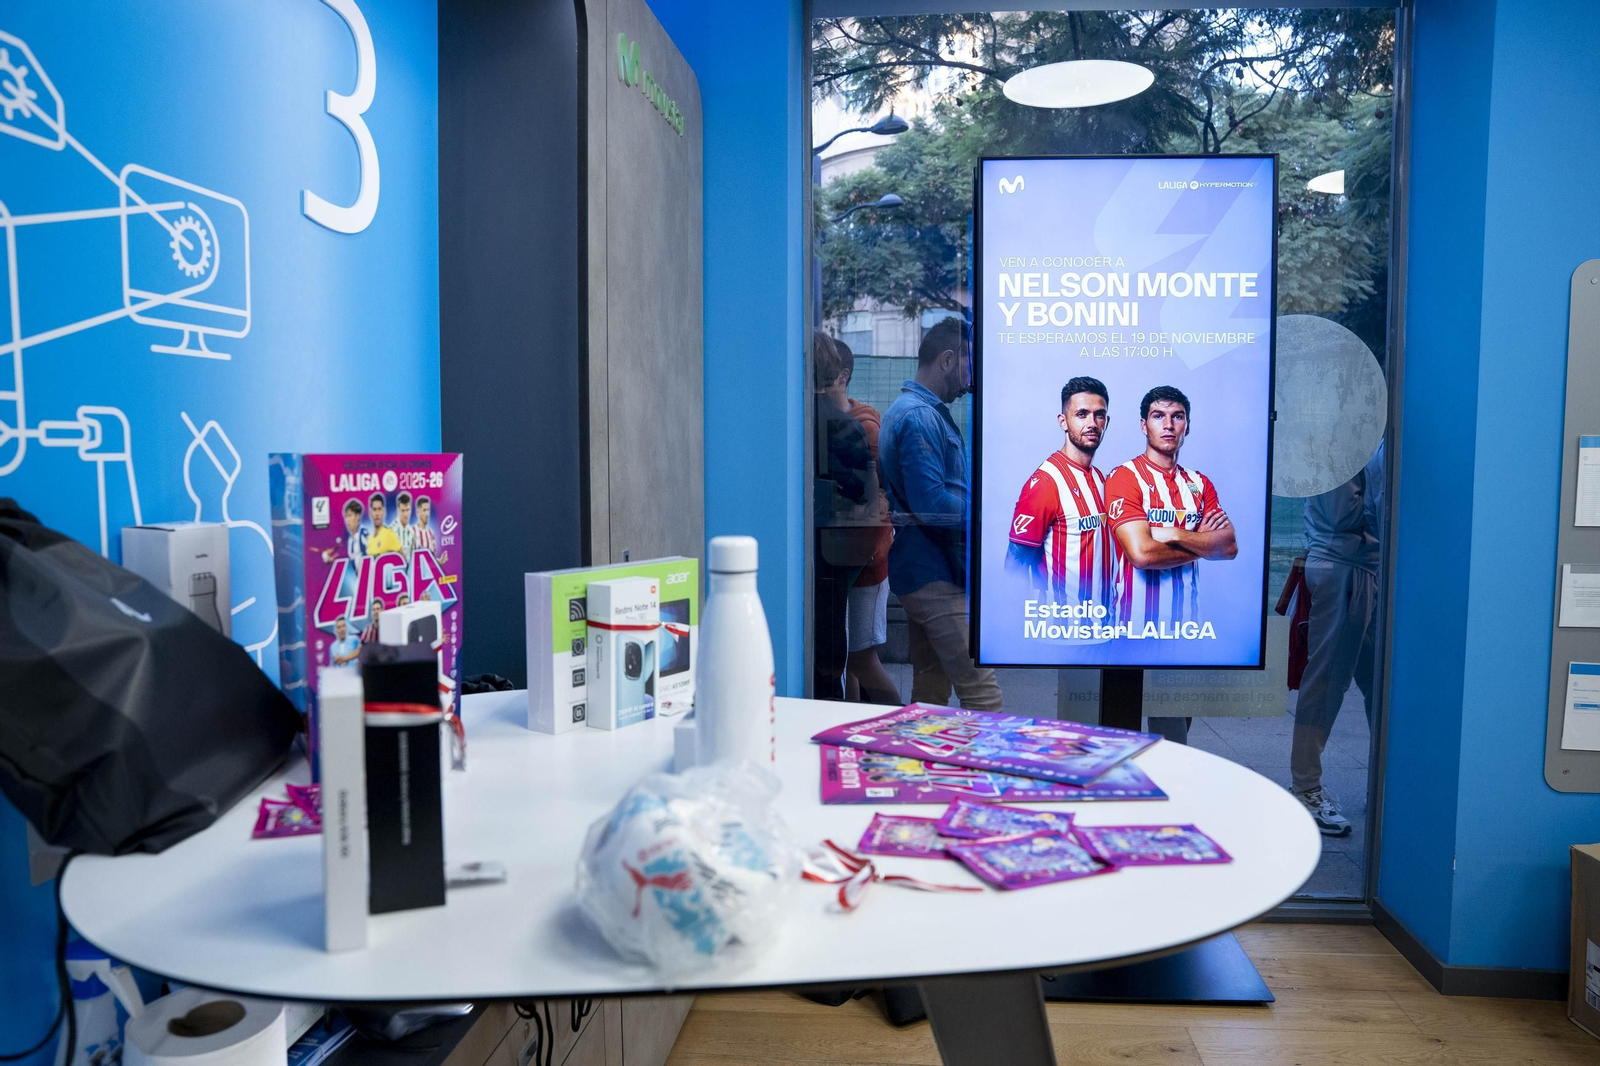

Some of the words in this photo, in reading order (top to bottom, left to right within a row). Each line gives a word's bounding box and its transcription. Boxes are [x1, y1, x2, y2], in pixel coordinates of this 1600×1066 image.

[302, 0, 380, 233] 3
[1158, 181, 1188, 190] LALIGA
[999, 256, 1026, 268] VEN
[1029, 256, 1039, 268] A
[1042, 256, 1112, 268] CONOCER
[1115, 256, 1125, 268] A
[998, 272, 1129, 298] NELSON
[1137, 272, 1258, 298] MONTE
[997, 301, 1022, 327] Y
[1027, 301, 1139, 327] BONINI
[998, 332, 1015, 344] TE
[1019, 332, 1107, 344] ESPERAMOS
[1111, 332, 1128, 344] EL
[1131, 332, 1146, 344] 19
[1149, 332, 1168, 344] DE
[1171, 332, 1255, 344] NOVIEMBRE
[1080, 346, 1090, 358] A
[1093, 346, 1120, 358] LAS
[1123, 346, 1159, 358] 17:00
[1163, 346, 1173, 358] H
[330, 472, 380, 493] LALIGA
[400, 471, 443, 490] 2025-26
[1078, 515, 1101, 531] KUDU
[1147, 508, 1175, 523] KUDU
[666, 571, 691, 584] acer
[314, 548, 458, 629] LIGA
[615, 606, 633, 615] Redmi
[634, 603, 649, 611] Note
[650, 601, 656, 609] 14
[1024, 600, 1107, 619] Estadio
[1024, 620, 1217, 640] MovistarLALIGA
